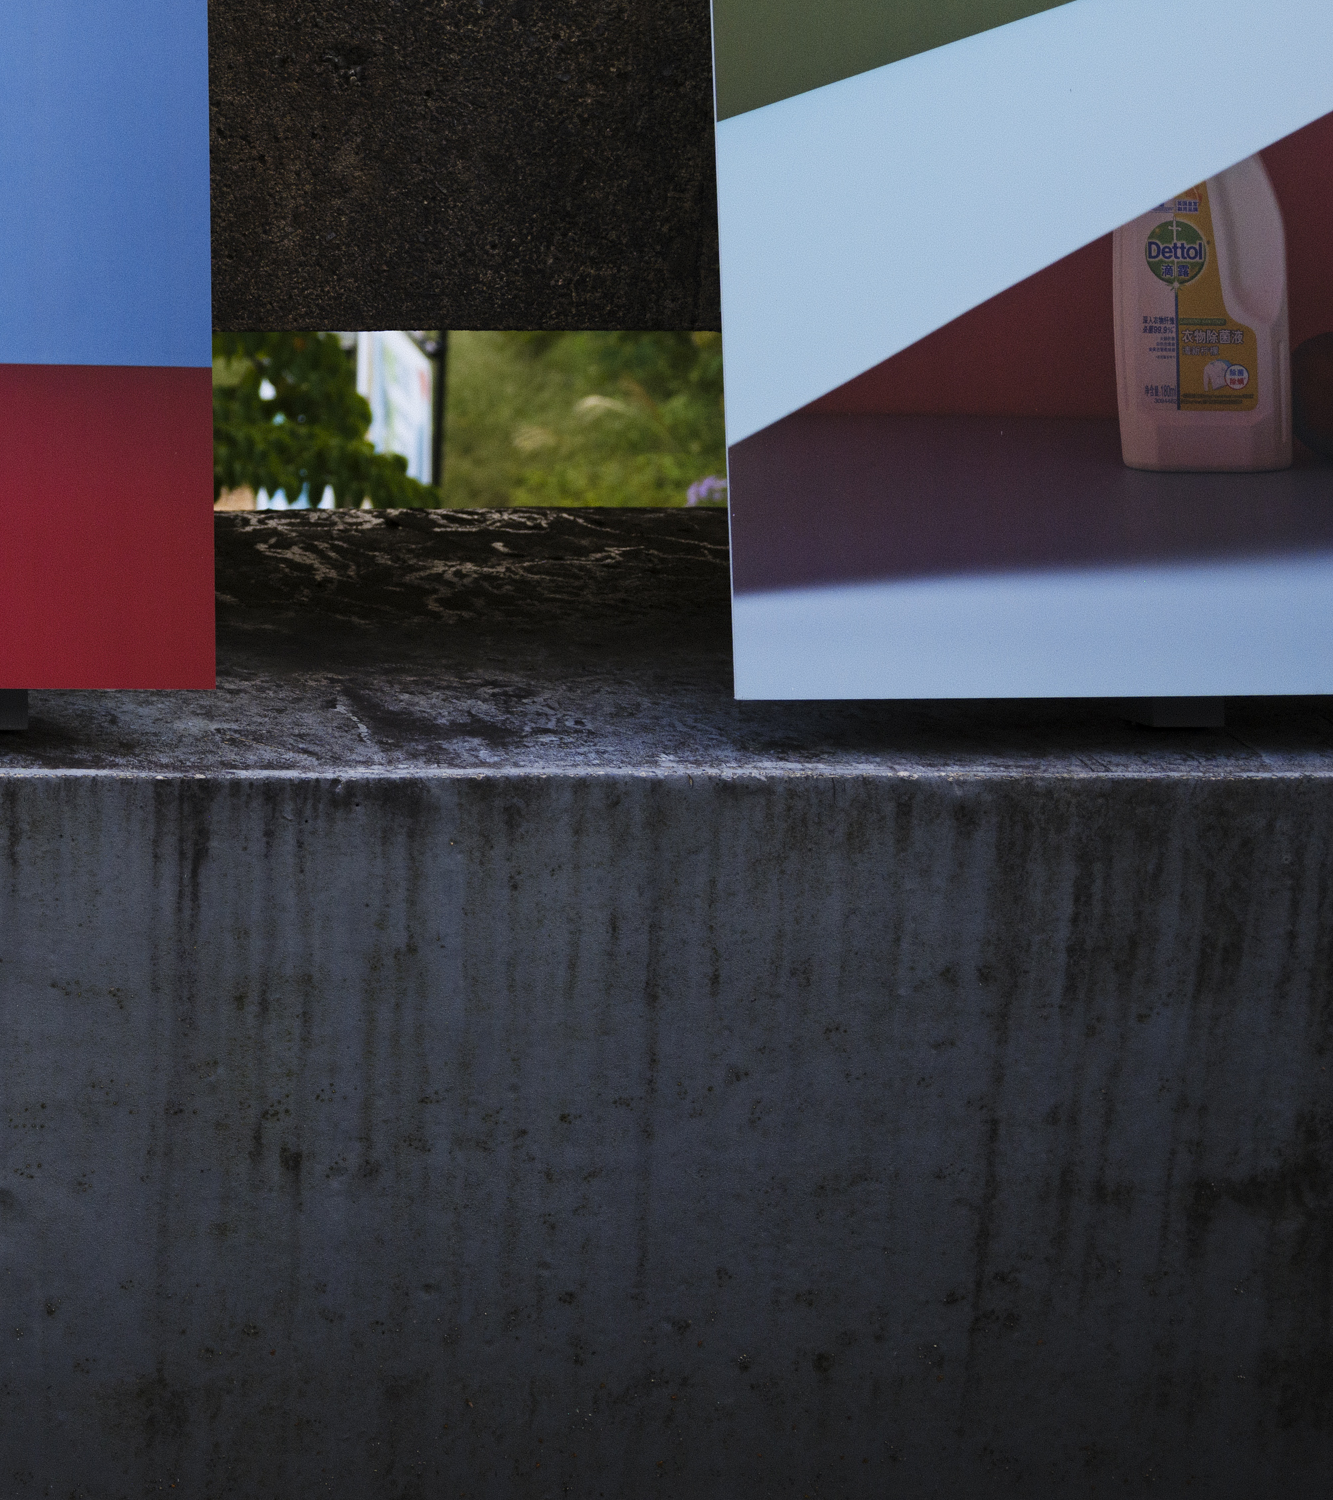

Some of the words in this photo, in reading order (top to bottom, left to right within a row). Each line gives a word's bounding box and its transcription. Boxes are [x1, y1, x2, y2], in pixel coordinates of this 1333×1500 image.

[1147, 241, 1203, 260] Dettol
[1161, 264, 1190, 277] 滴露
[1181, 329, 1244, 345] 衣物除菌液
